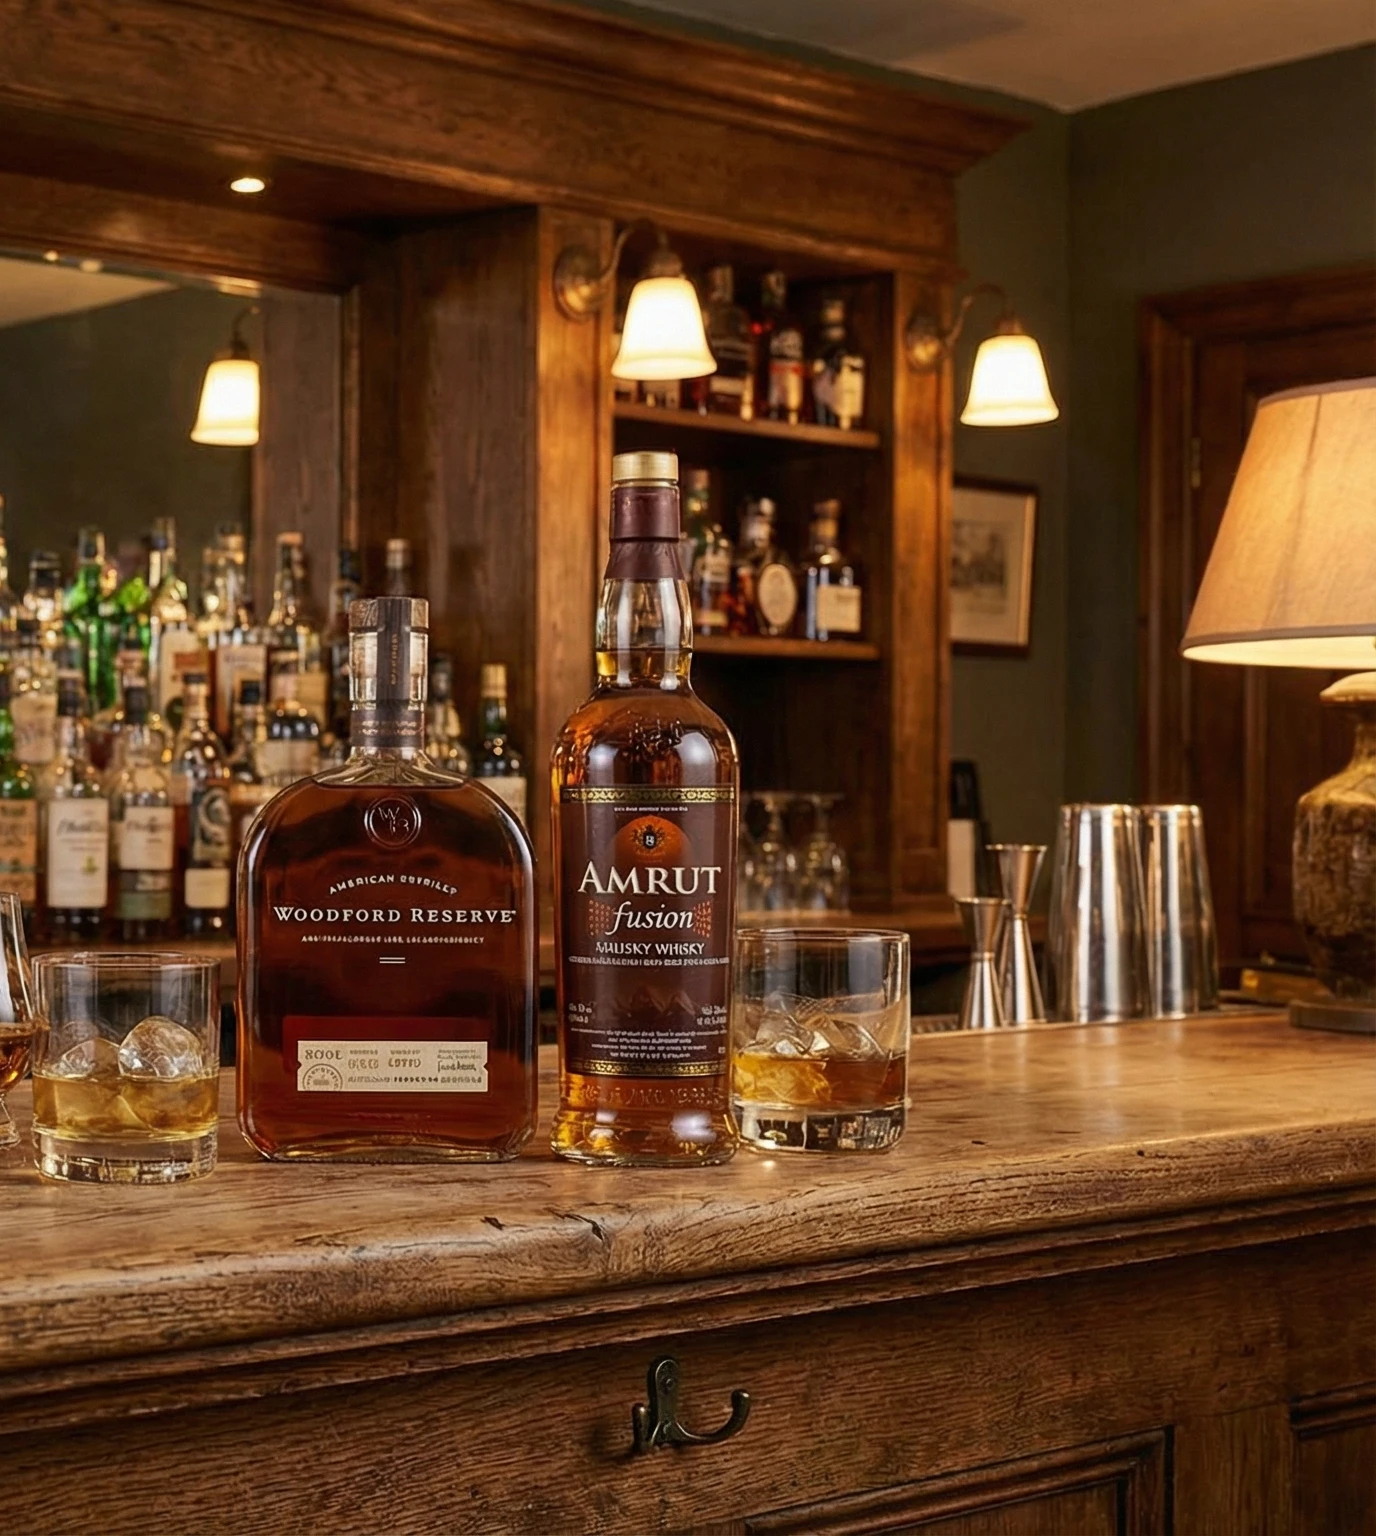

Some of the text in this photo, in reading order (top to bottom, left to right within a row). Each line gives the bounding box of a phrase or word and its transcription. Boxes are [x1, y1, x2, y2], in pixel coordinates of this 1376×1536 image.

[577, 860, 722, 895] AMRUT
[273, 906, 513, 923] WOODFORD RESERVE
[604, 900, 694, 936] fusion
